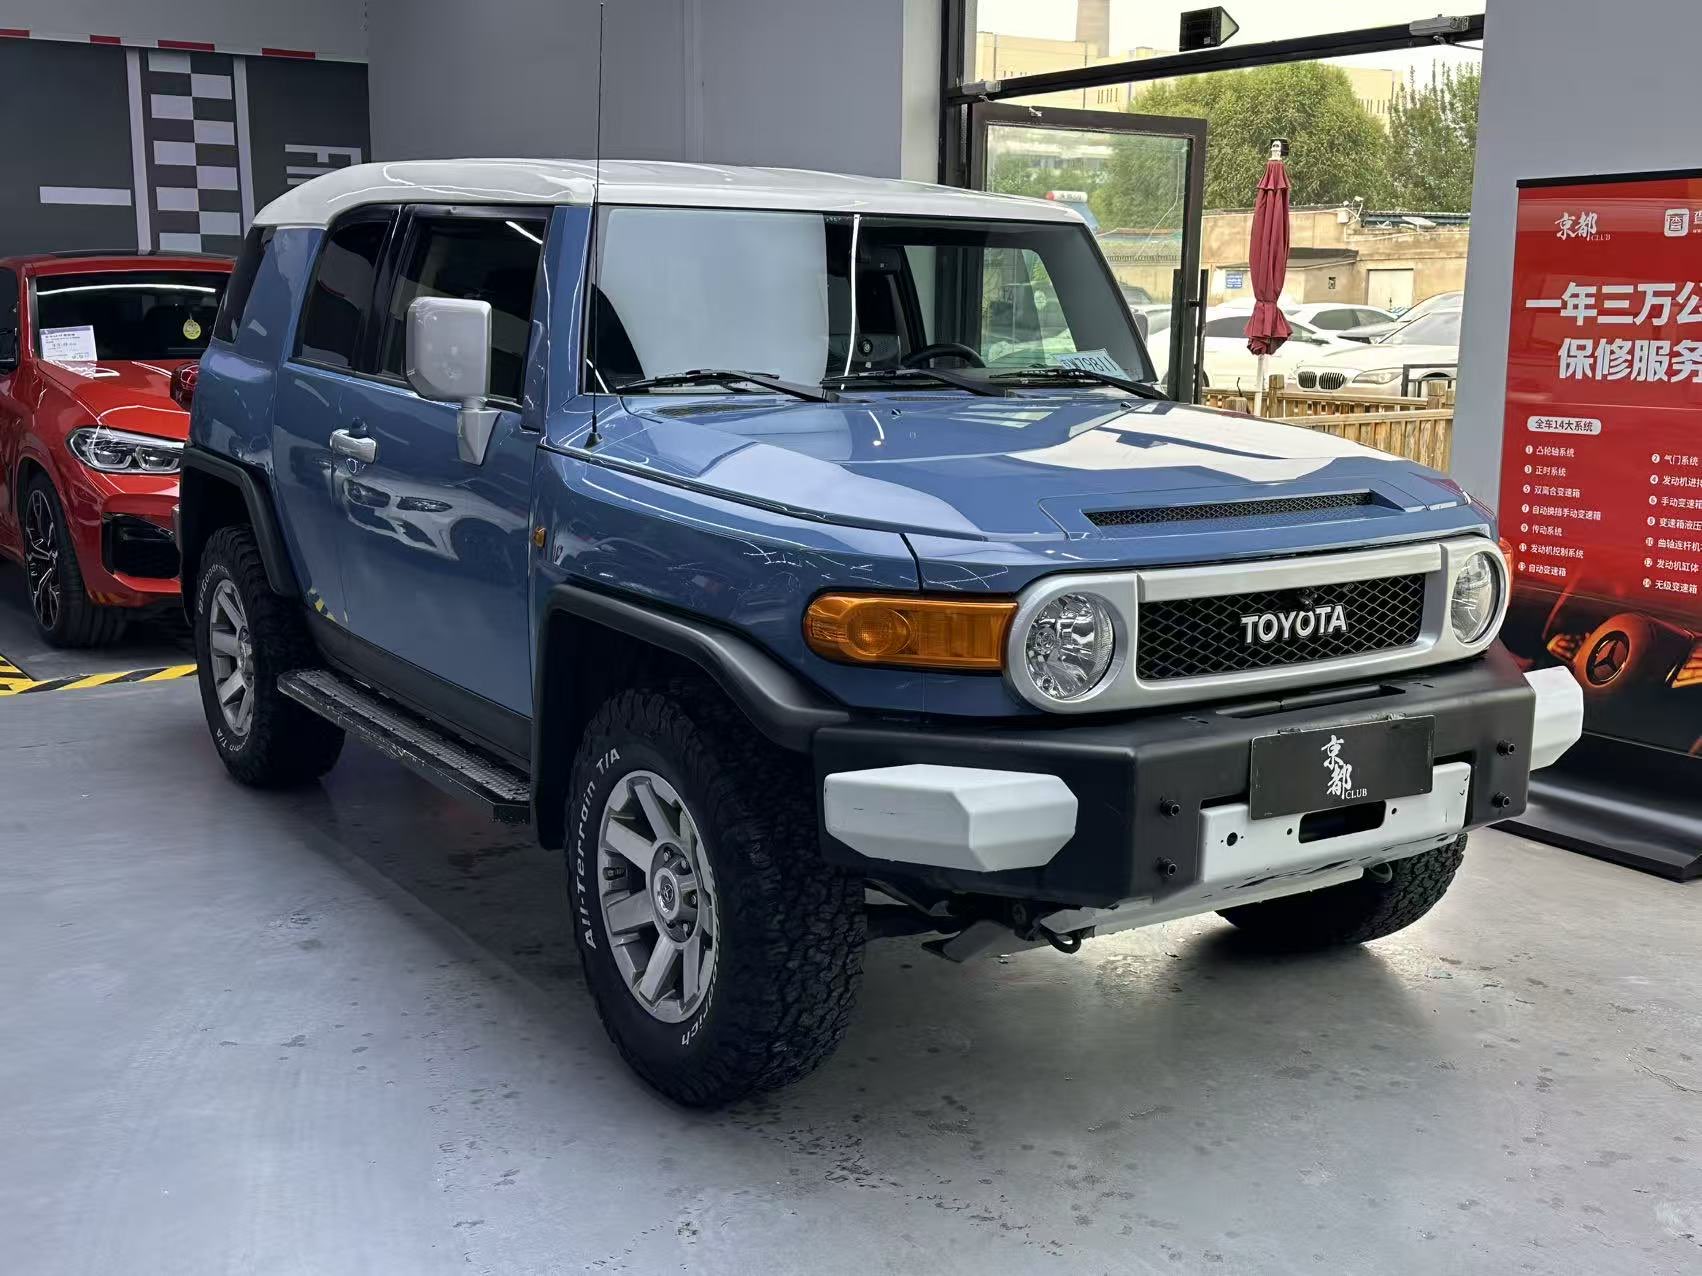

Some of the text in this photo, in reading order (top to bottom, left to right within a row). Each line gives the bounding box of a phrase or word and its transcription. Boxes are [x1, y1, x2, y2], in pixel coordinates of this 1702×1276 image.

[1554, 211, 1598, 241] 京都
[1558, 338, 1702, 383] 保修服务
[1535, 418, 1593, 432] 全车14大系统
[1664, 454, 1699, 466] 气门系统
[1535, 465, 1567, 477] 正时系统
[1534, 485, 1580, 498] 双离合变速箱
[1532, 524, 1562, 536] 传动系统
[1657, 539, 1702, 552] 曲轴连杆机
[1528, 563, 1566, 577] 自动变速箱
[1656, 558, 1699, 573] 发动机缸体
[1655, 580, 1698, 594] 无级变速箱
[1240, 603, 1348, 644] TOYOTA
[1321, 734, 1367, 800] 京都 CLUB
[576, 748, 621, 949] All-Terrain T/A
